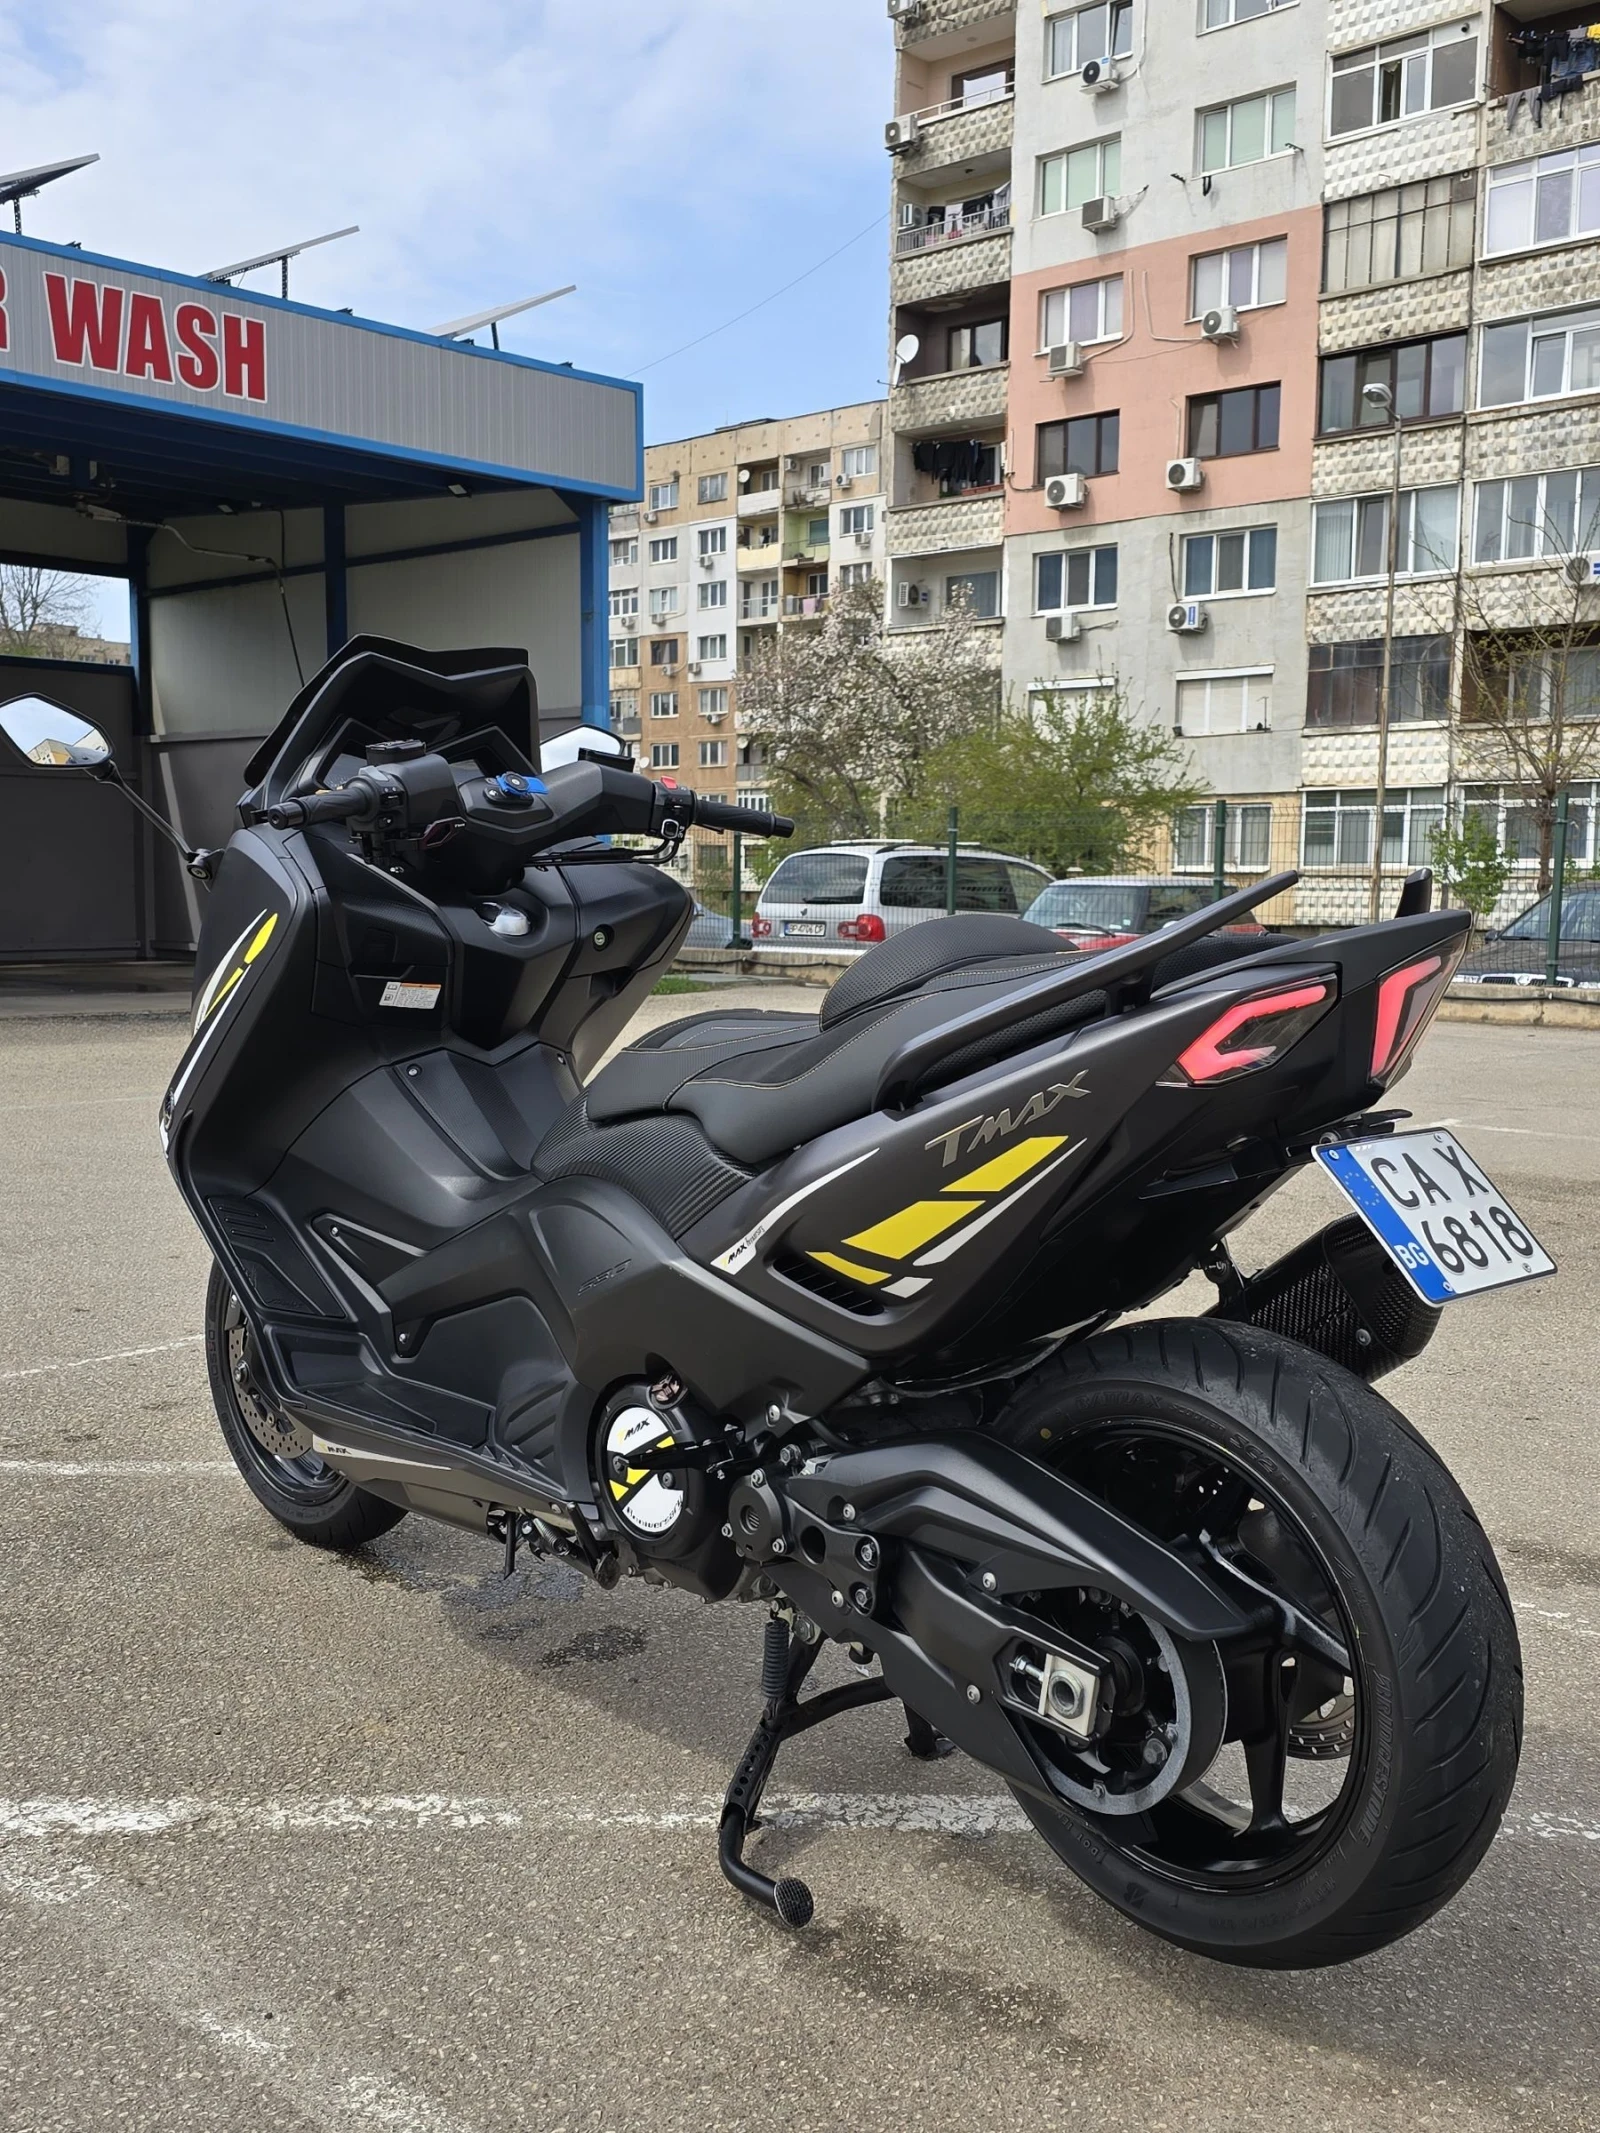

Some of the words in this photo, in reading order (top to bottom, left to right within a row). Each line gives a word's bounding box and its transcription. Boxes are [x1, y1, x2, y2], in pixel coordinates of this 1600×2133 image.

[43, 271, 267, 404] WASH
[925, 1069, 1091, 1167] TMAX
[1370, 1152, 1452, 1210] CA
[1433, 1145, 1489, 1197] X
[1394, 1242, 1429, 1269] BG
[1421, 1206, 1534, 1275] 6818
